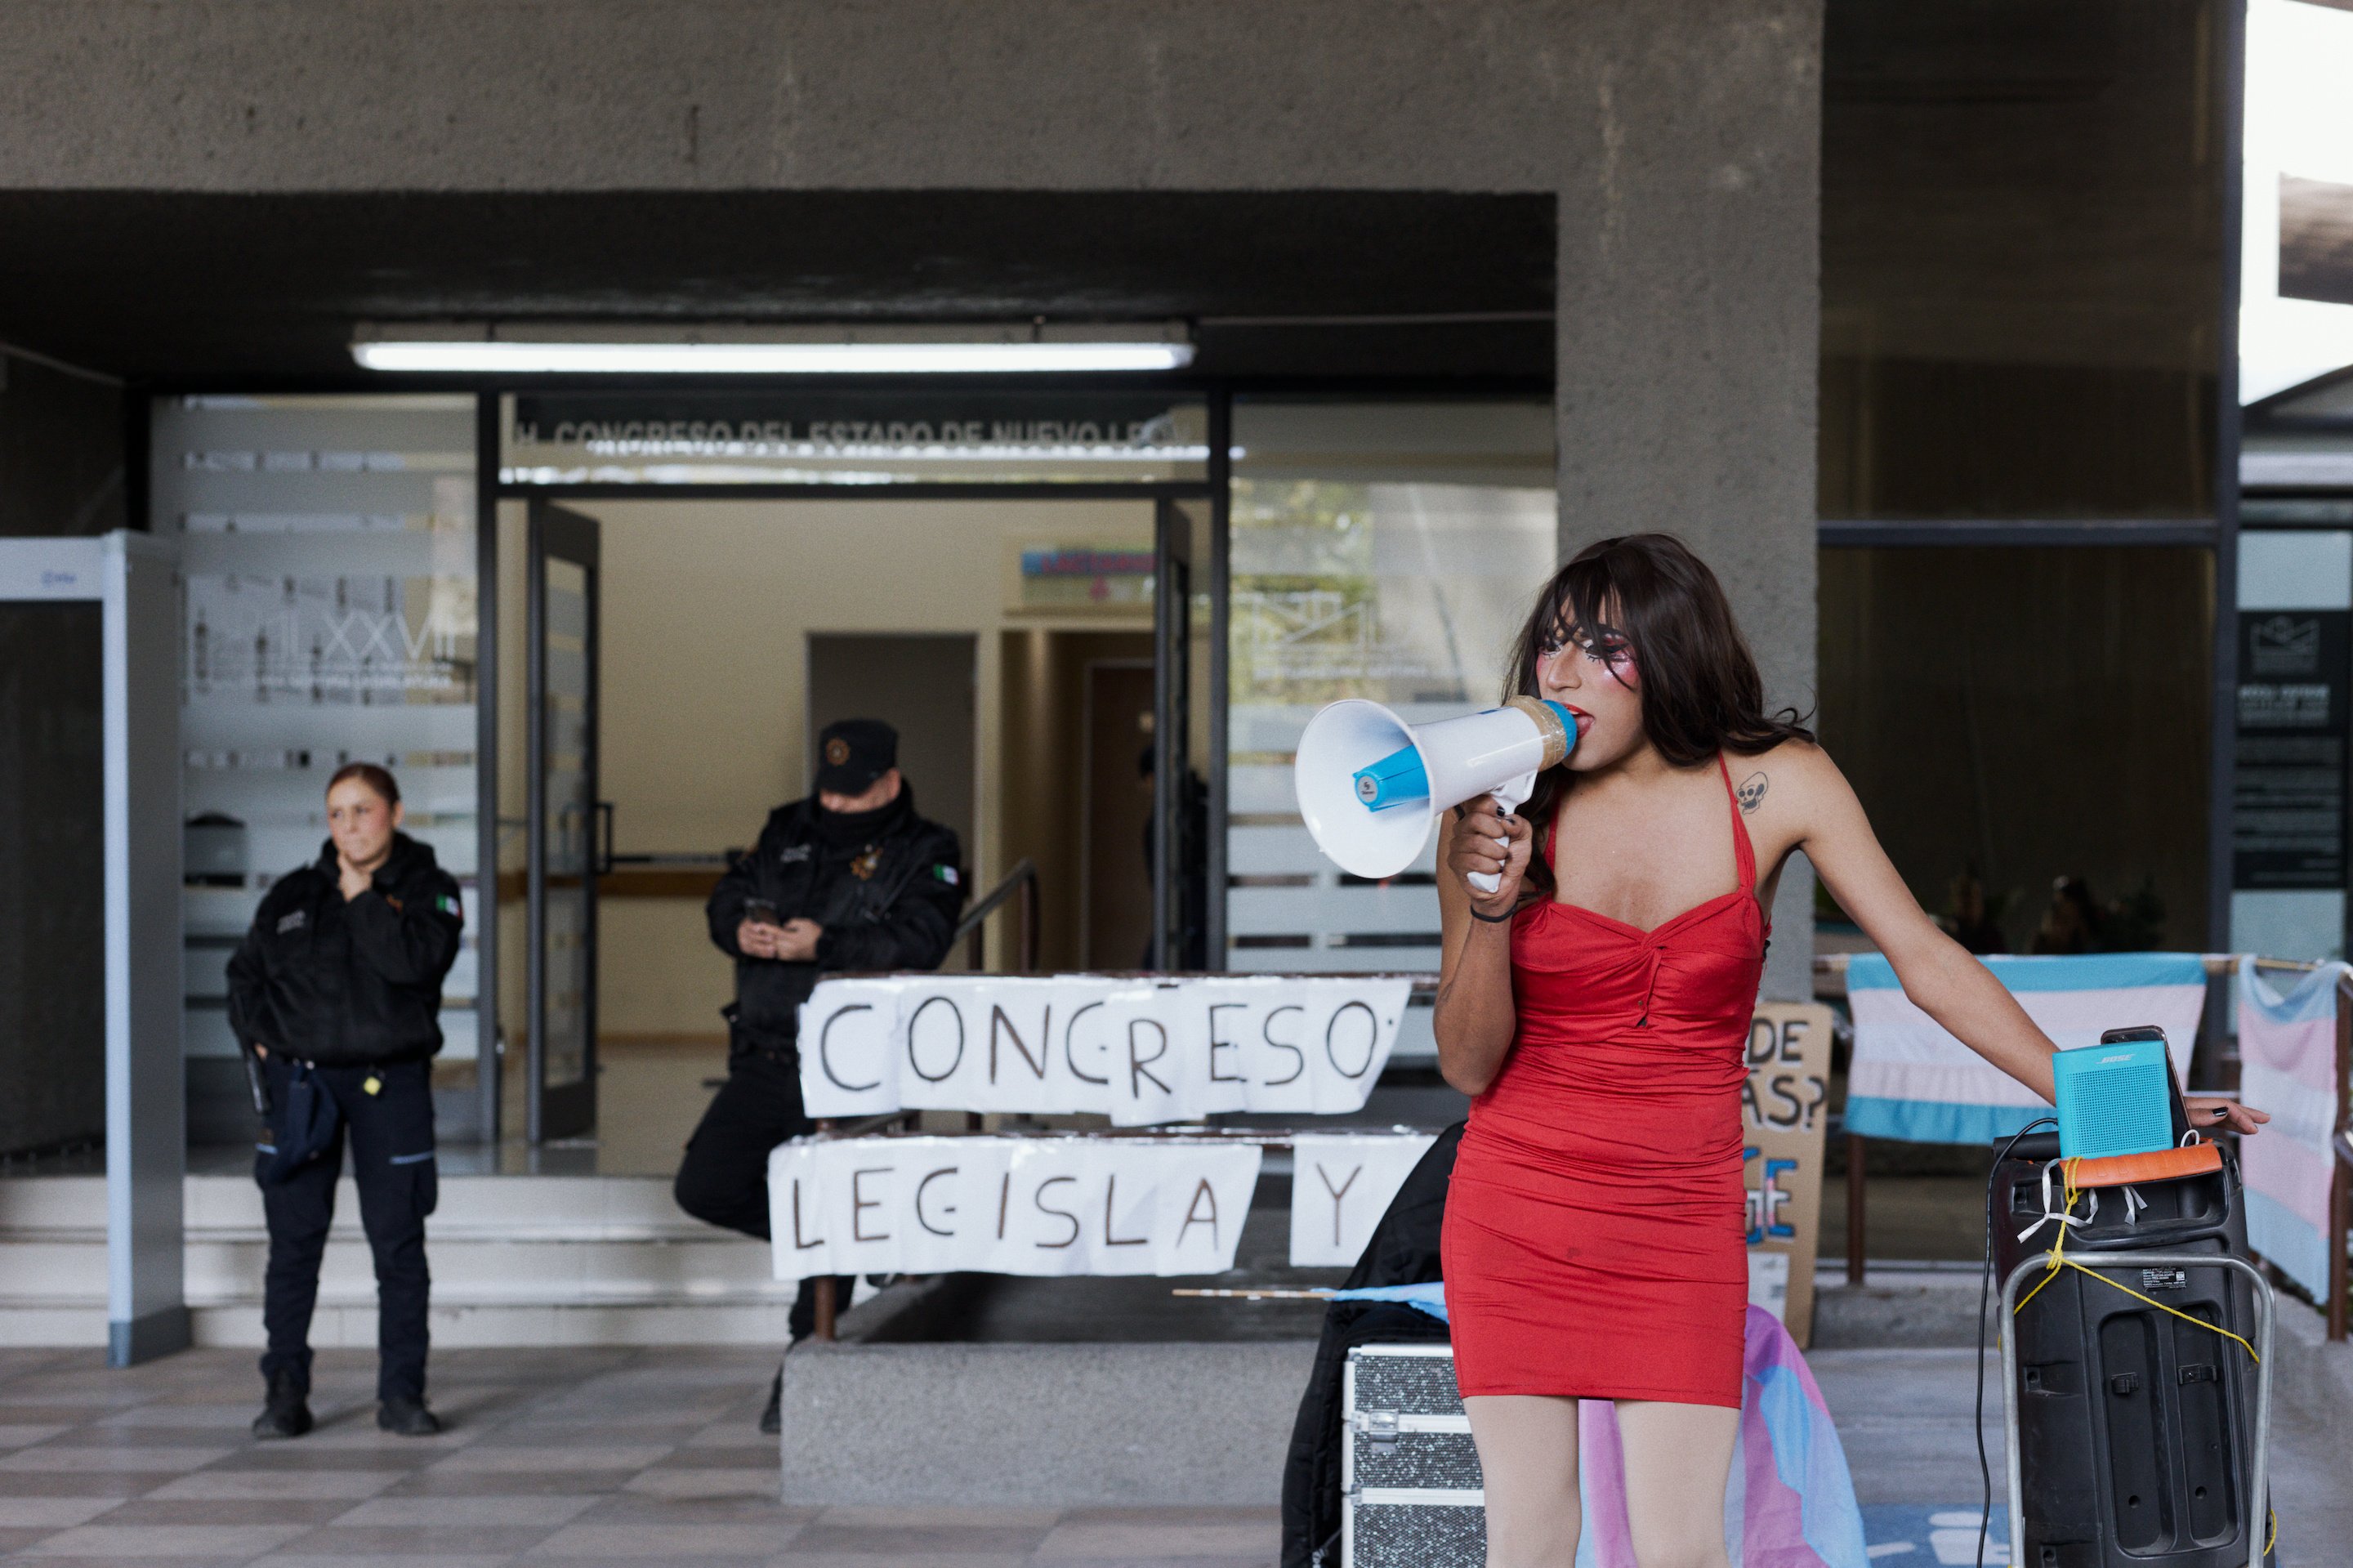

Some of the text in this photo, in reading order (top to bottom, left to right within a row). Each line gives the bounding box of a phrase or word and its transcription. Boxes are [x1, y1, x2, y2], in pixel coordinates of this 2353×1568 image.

[554, 419, 734, 447] CONGRESO
[739, 419, 792, 447] DEL
[809, 419, 933, 447] ESTADO
[941, 419, 982, 447] DE
[991, 419, 1101, 447] NUEVO
[820, 996, 1377, 1099] CONGRESO
[2095, 1053, 2136, 1064] BOSE
[793, 1164, 1363, 1251] LEGISLA Y
